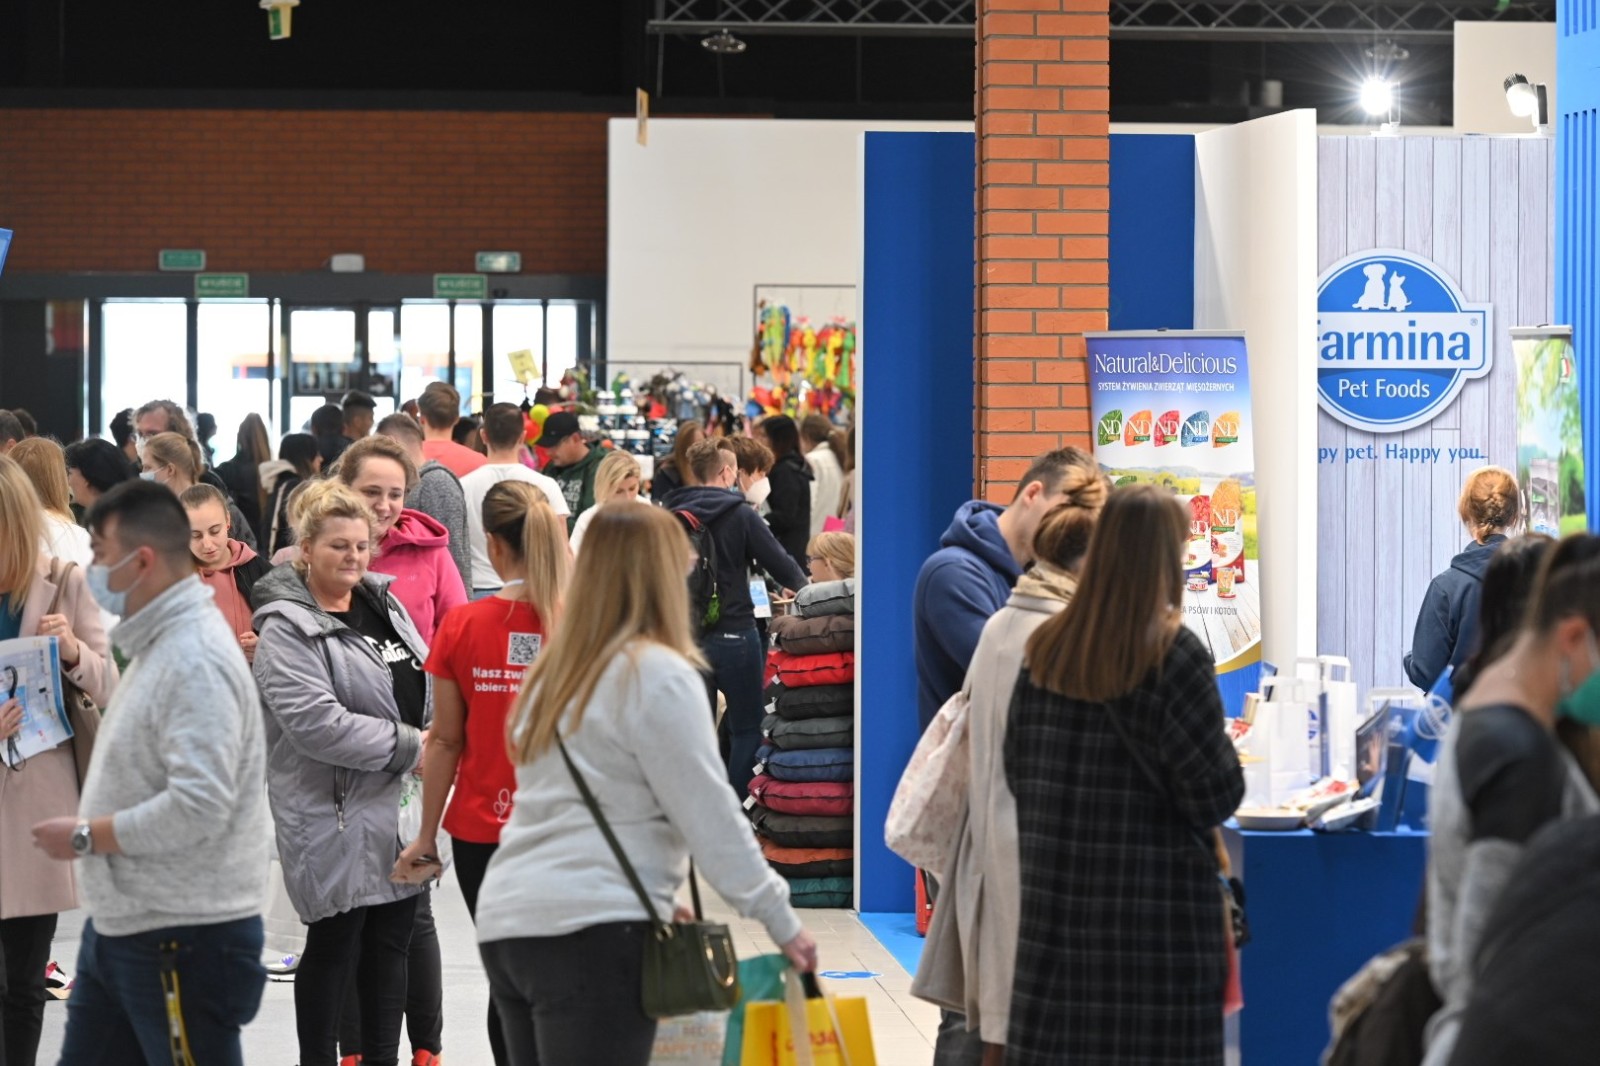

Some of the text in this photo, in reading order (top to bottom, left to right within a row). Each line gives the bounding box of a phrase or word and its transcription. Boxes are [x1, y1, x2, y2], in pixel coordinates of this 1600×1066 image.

[1318, 320, 1470, 361] armina
[1095, 352, 1237, 374] Natural&Delicious
[1098, 380, 1235, 394] SYSTEM ŻYWIENIA ZWIERZĄT MIĘSOŻERNYCH
[1339, 378, 1430, 398] Pet Foods
[1345, 445, 1378, 464] pet.
[1386, 443, 1441, 464] Happy
[1449, 446, 1485, 464] you.
[1188, 605, 1209, 615] PSÓW
[472, 666, 527, 680] Nasz zwi
[474, 681, 508, 692] obierz
